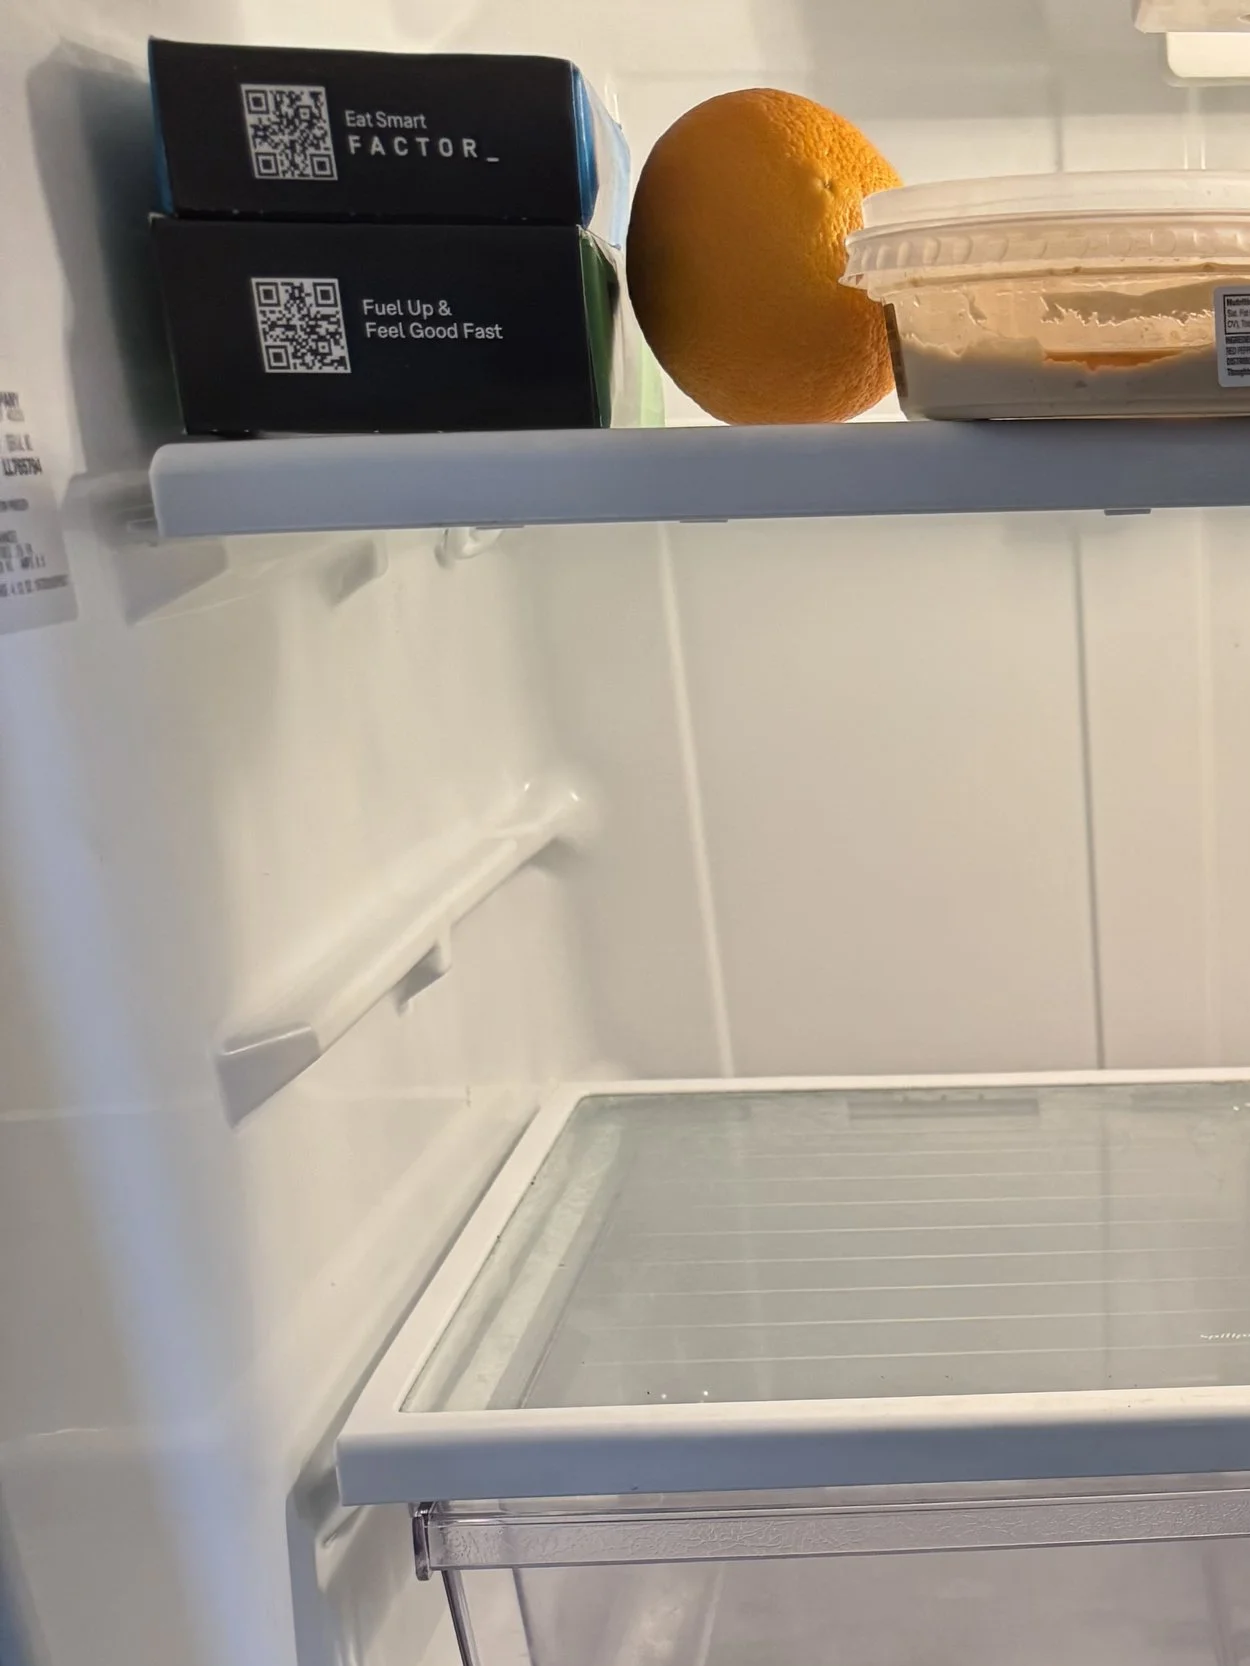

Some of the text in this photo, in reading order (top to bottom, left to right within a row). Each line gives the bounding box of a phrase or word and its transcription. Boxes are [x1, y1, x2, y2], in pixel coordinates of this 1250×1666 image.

[344, 109, 428, 130] Eat Smart
[363, 298, 453, 321] Fuel Up &
[365, 321, 504, 340] Feel Good Fast
